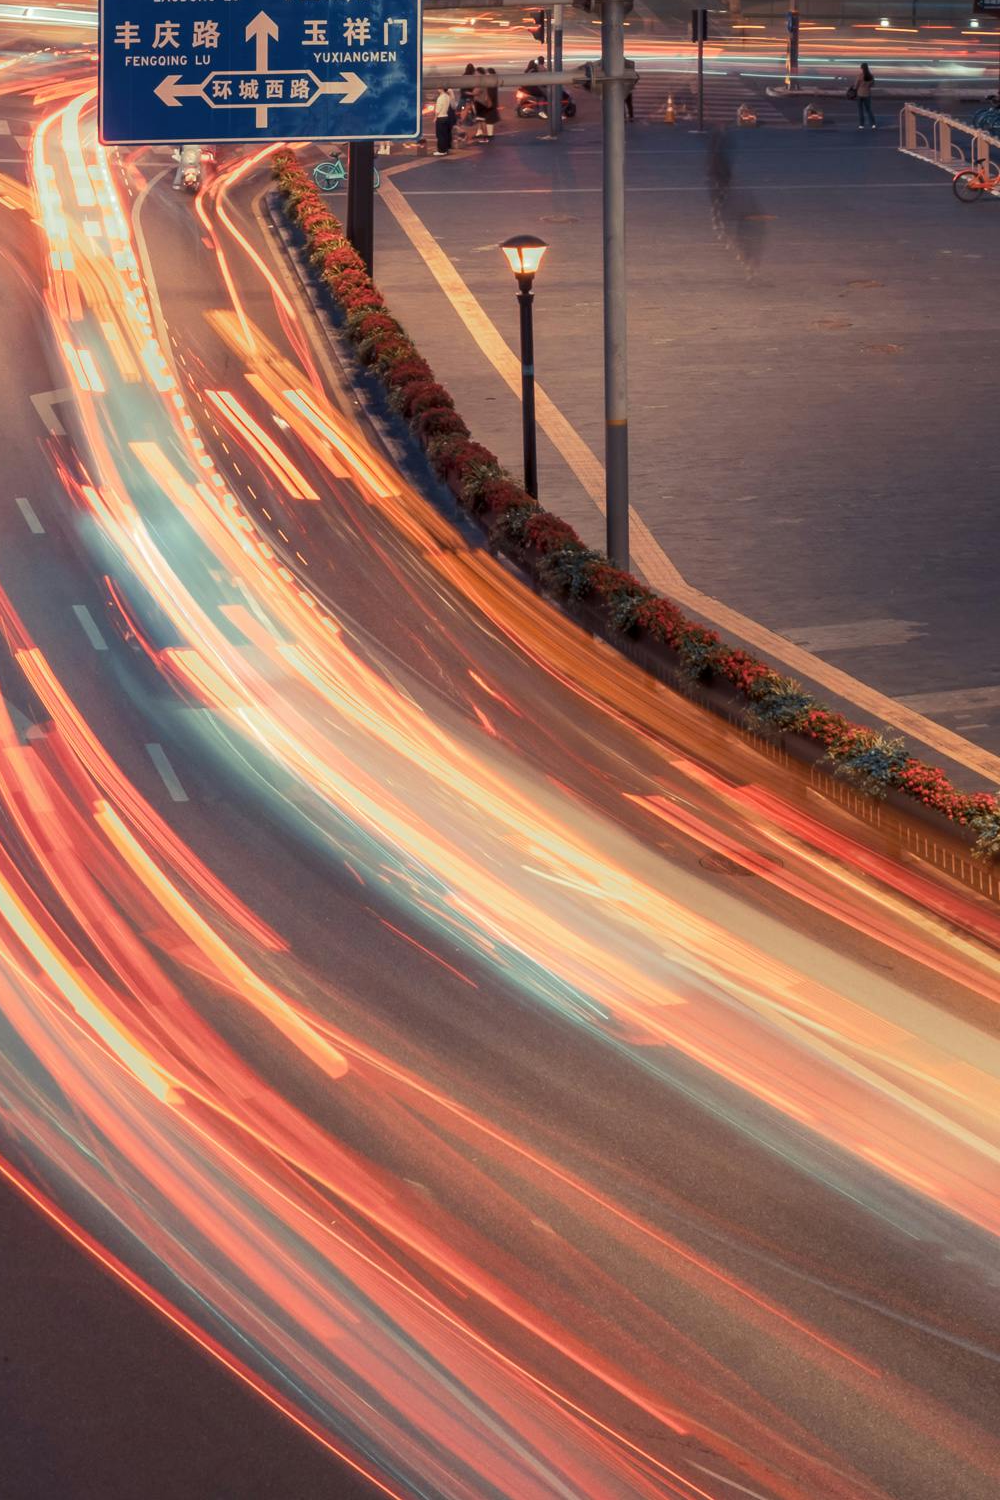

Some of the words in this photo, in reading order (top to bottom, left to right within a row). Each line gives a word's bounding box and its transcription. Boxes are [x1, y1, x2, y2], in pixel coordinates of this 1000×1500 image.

[114, 20, 221, 50] 丰庆路
[301, 17, 408, 46] 玉祥门
[125, 55, 188, 67] FENGQING
[195, 55, 211, 65] LU
[313, 51, 397, 63] YUXIANGMEN
[212, 79, 311, 100] 环城西路
